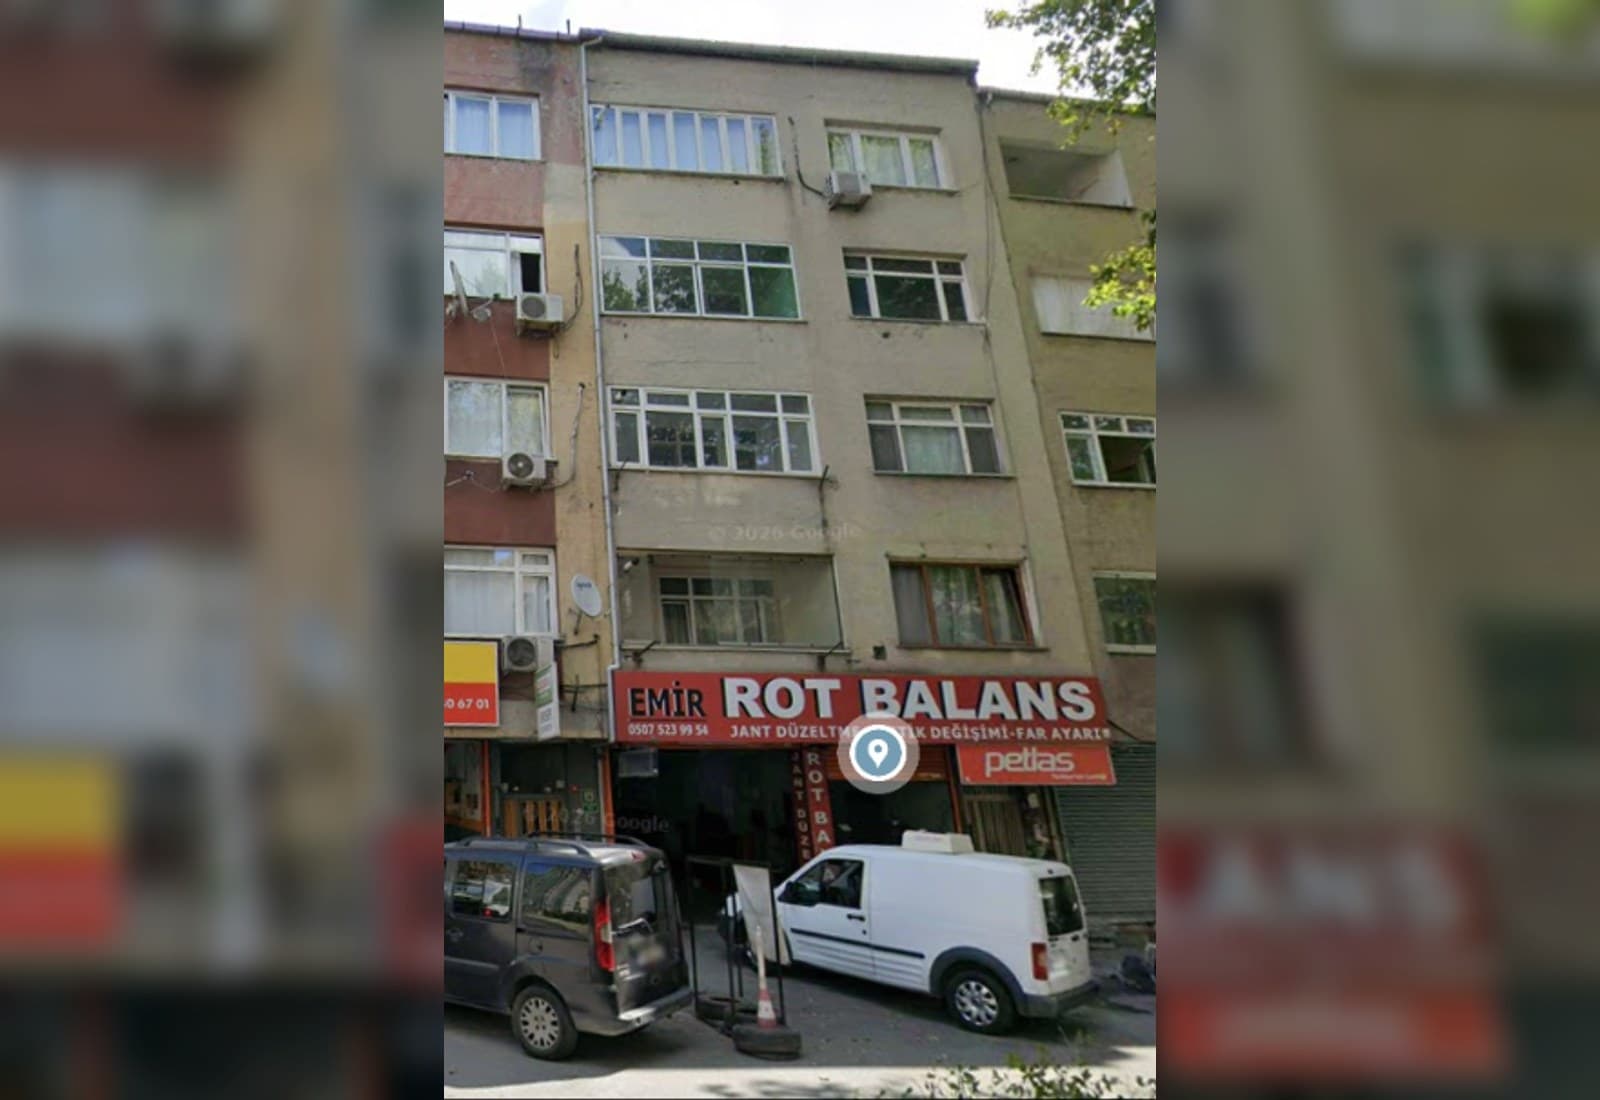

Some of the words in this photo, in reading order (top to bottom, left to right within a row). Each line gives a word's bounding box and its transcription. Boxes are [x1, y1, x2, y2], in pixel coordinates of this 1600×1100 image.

[457, 698, 474, 710] 67
[475, 699, 490, 711] 01
[627, 681, 706, 718] EMİR
[722, 677, 841, 718] ROT
[860, 679, 1096, 721] BALANS
[627, 723, 655, 736] 0507
[658, 723, 678, 736] 523
[730, 725, 772, 738] JANT
[807, 751, 823, 803] ROT
[984, 746, 1076, 778] petlas
